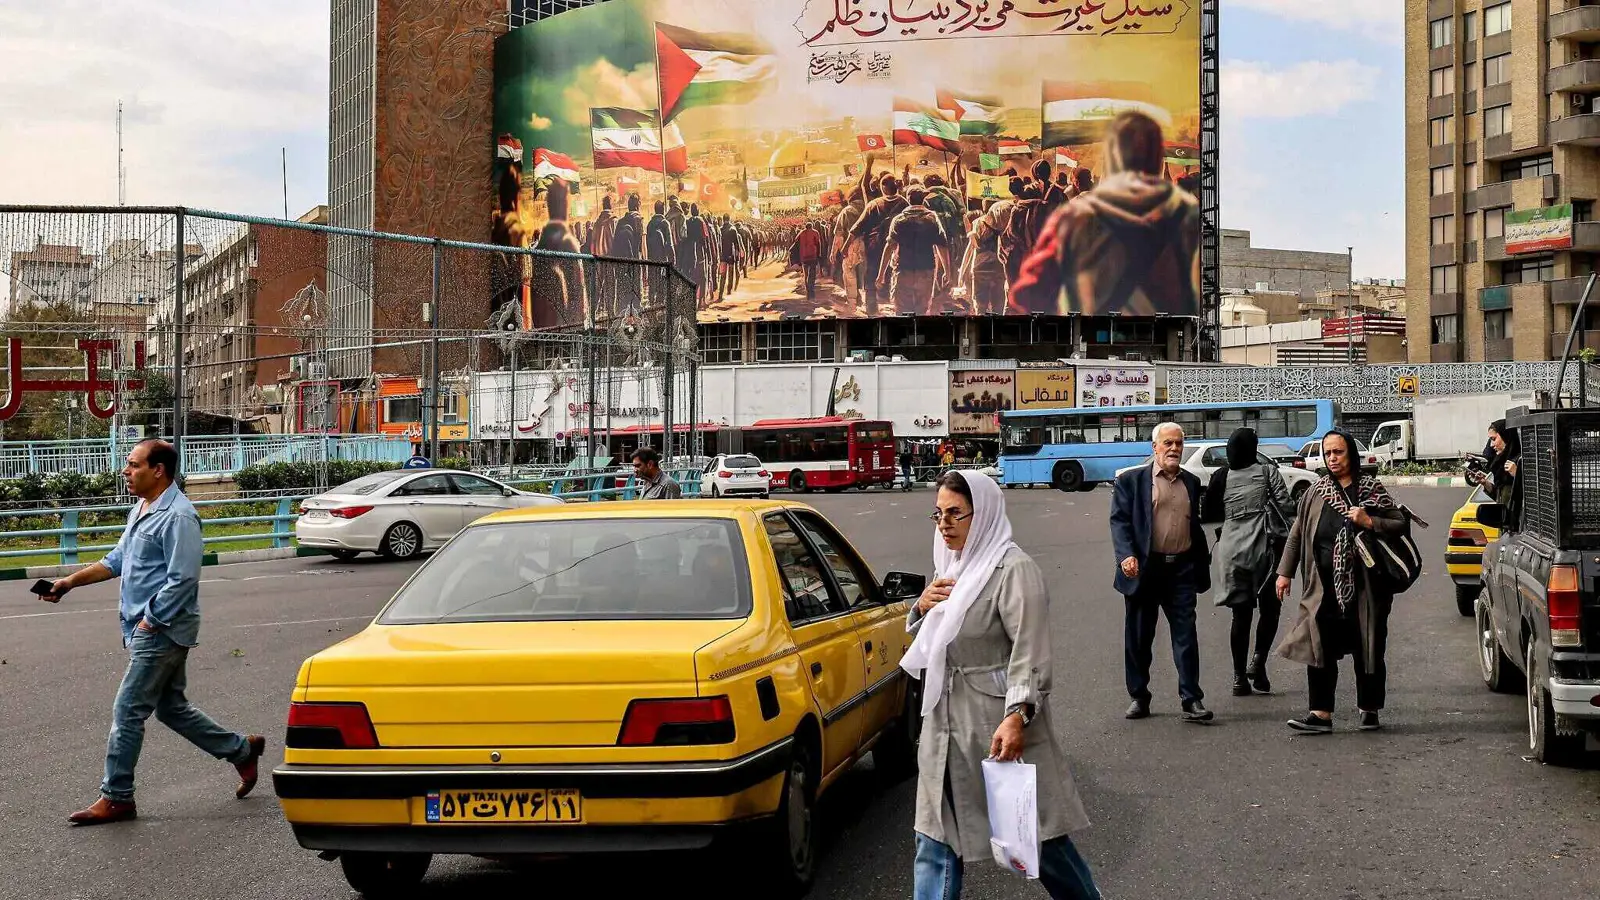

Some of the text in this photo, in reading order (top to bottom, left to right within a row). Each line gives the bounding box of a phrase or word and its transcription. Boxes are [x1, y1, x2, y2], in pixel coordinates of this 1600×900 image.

[799, 0, 863, 47] ظلم
[945, 0, 988, 35] برد
[972, 1, 1014, 31] می
[1014, 0, 1105, 33] غیرت
[1085, 368, 1149, 388] فست فود
[1367, 396, 1382, 404] Asr
[914, 415, 942, 428] موزه
[473, 792, 498, 802] TAXI
